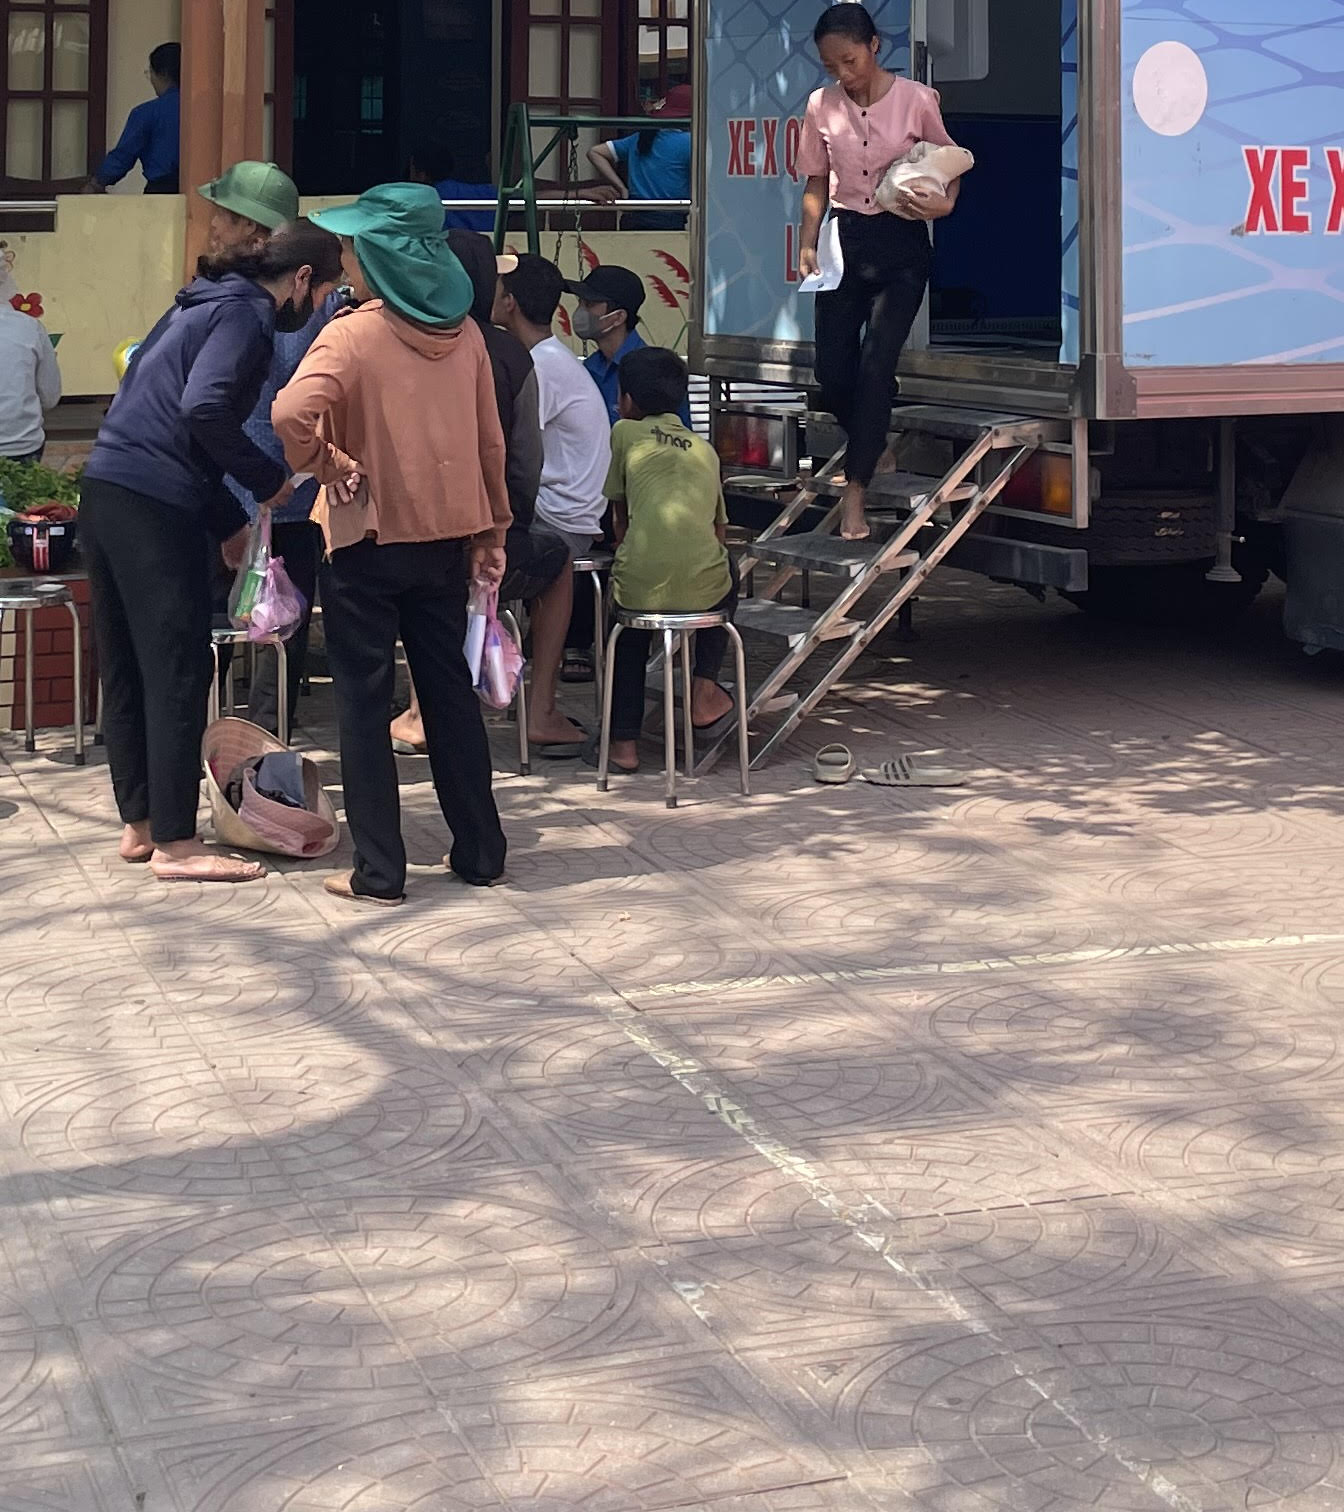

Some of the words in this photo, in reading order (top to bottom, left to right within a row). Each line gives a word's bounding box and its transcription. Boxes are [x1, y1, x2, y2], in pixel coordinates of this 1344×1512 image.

[727, 117, 756, 178] XE
[761, 117, 779, 178] X
[1241, 145, 1312, 236] XE
